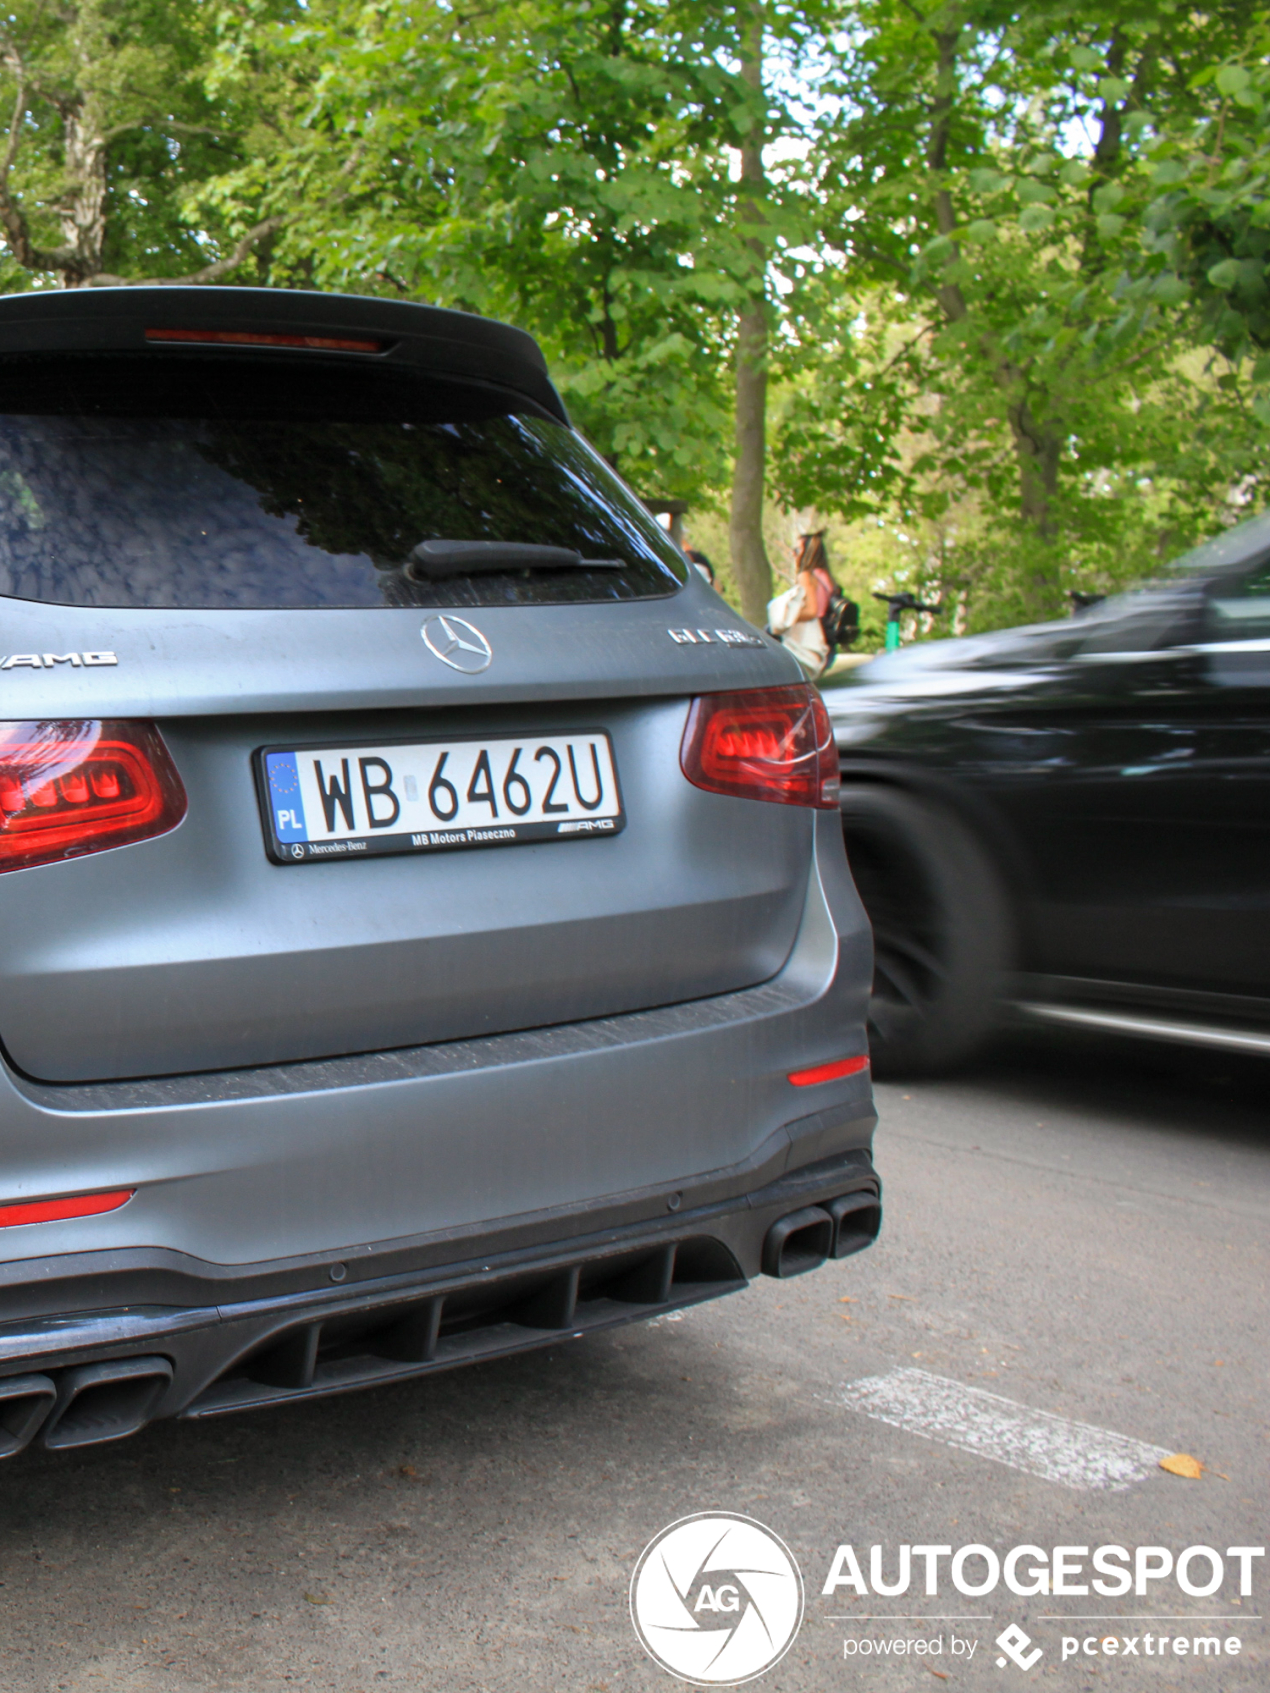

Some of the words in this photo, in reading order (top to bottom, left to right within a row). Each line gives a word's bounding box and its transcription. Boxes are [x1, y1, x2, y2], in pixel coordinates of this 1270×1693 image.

[1, 651, 119, 669] AMG
[313, 756, 401, 833] WB
[428, 743, 604, 822] 6462U
[277, 809, 302, 830] PL
[577, 819, 615, 831] AMG
[411, 833, 429, 846] MB
[429, 832, 466, 845] Motors
[466, 828, 516, 842] Piaseczno
[308, 841, 367, 855] Mercedes-Benz
